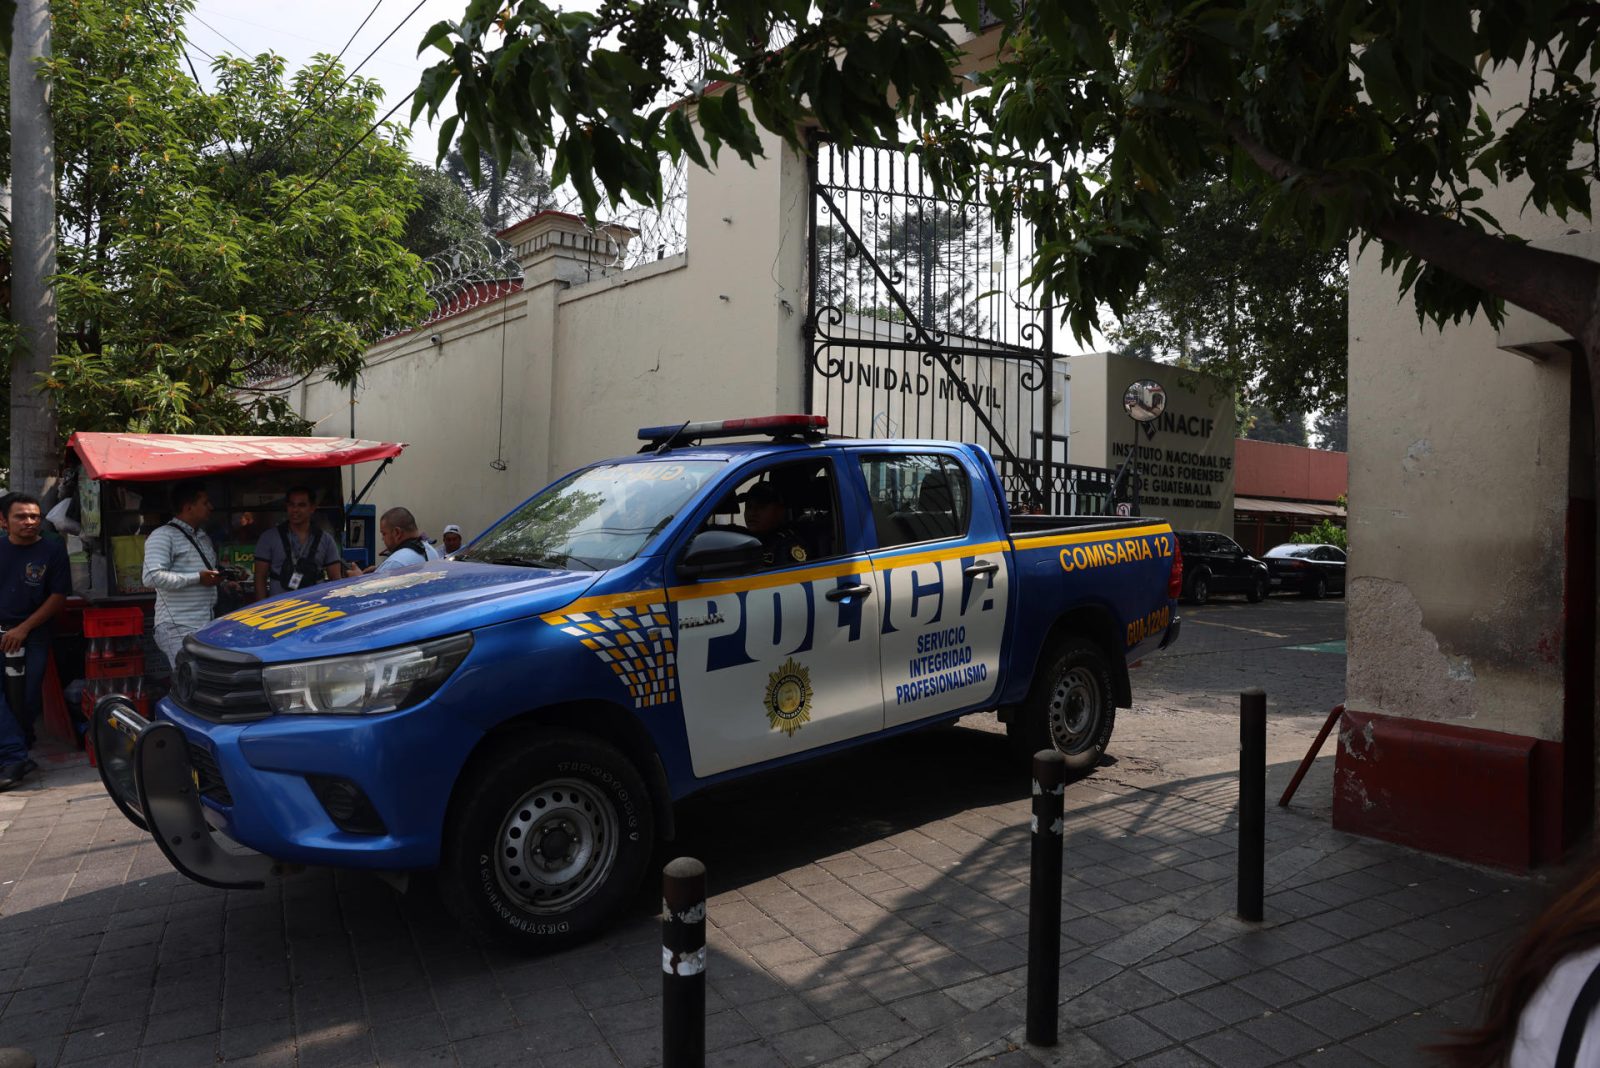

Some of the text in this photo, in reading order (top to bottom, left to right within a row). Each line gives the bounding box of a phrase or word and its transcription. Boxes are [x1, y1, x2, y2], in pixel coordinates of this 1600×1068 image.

[840, 360, 929, 397] UNIDAD
[1158, 411, 1214, 439] INACIF
[1167, 450, 1218, 470] NACIONAL
[1220, 457, 1232, 471] DE
[1178, 466, 1224, 483] FORENSES
[1152, 480, 1212, 497] GUATEMALA
[1059, 535, 1172, 572] COMISARIA 12
[677, 552, 1009, 672] POLICIA
[916, 625, 966, 654] SERVICIO
[909, 648, 972, 678] INTEGRIDAD
[896, 664, 988, 706] PROFESIONALISMO
